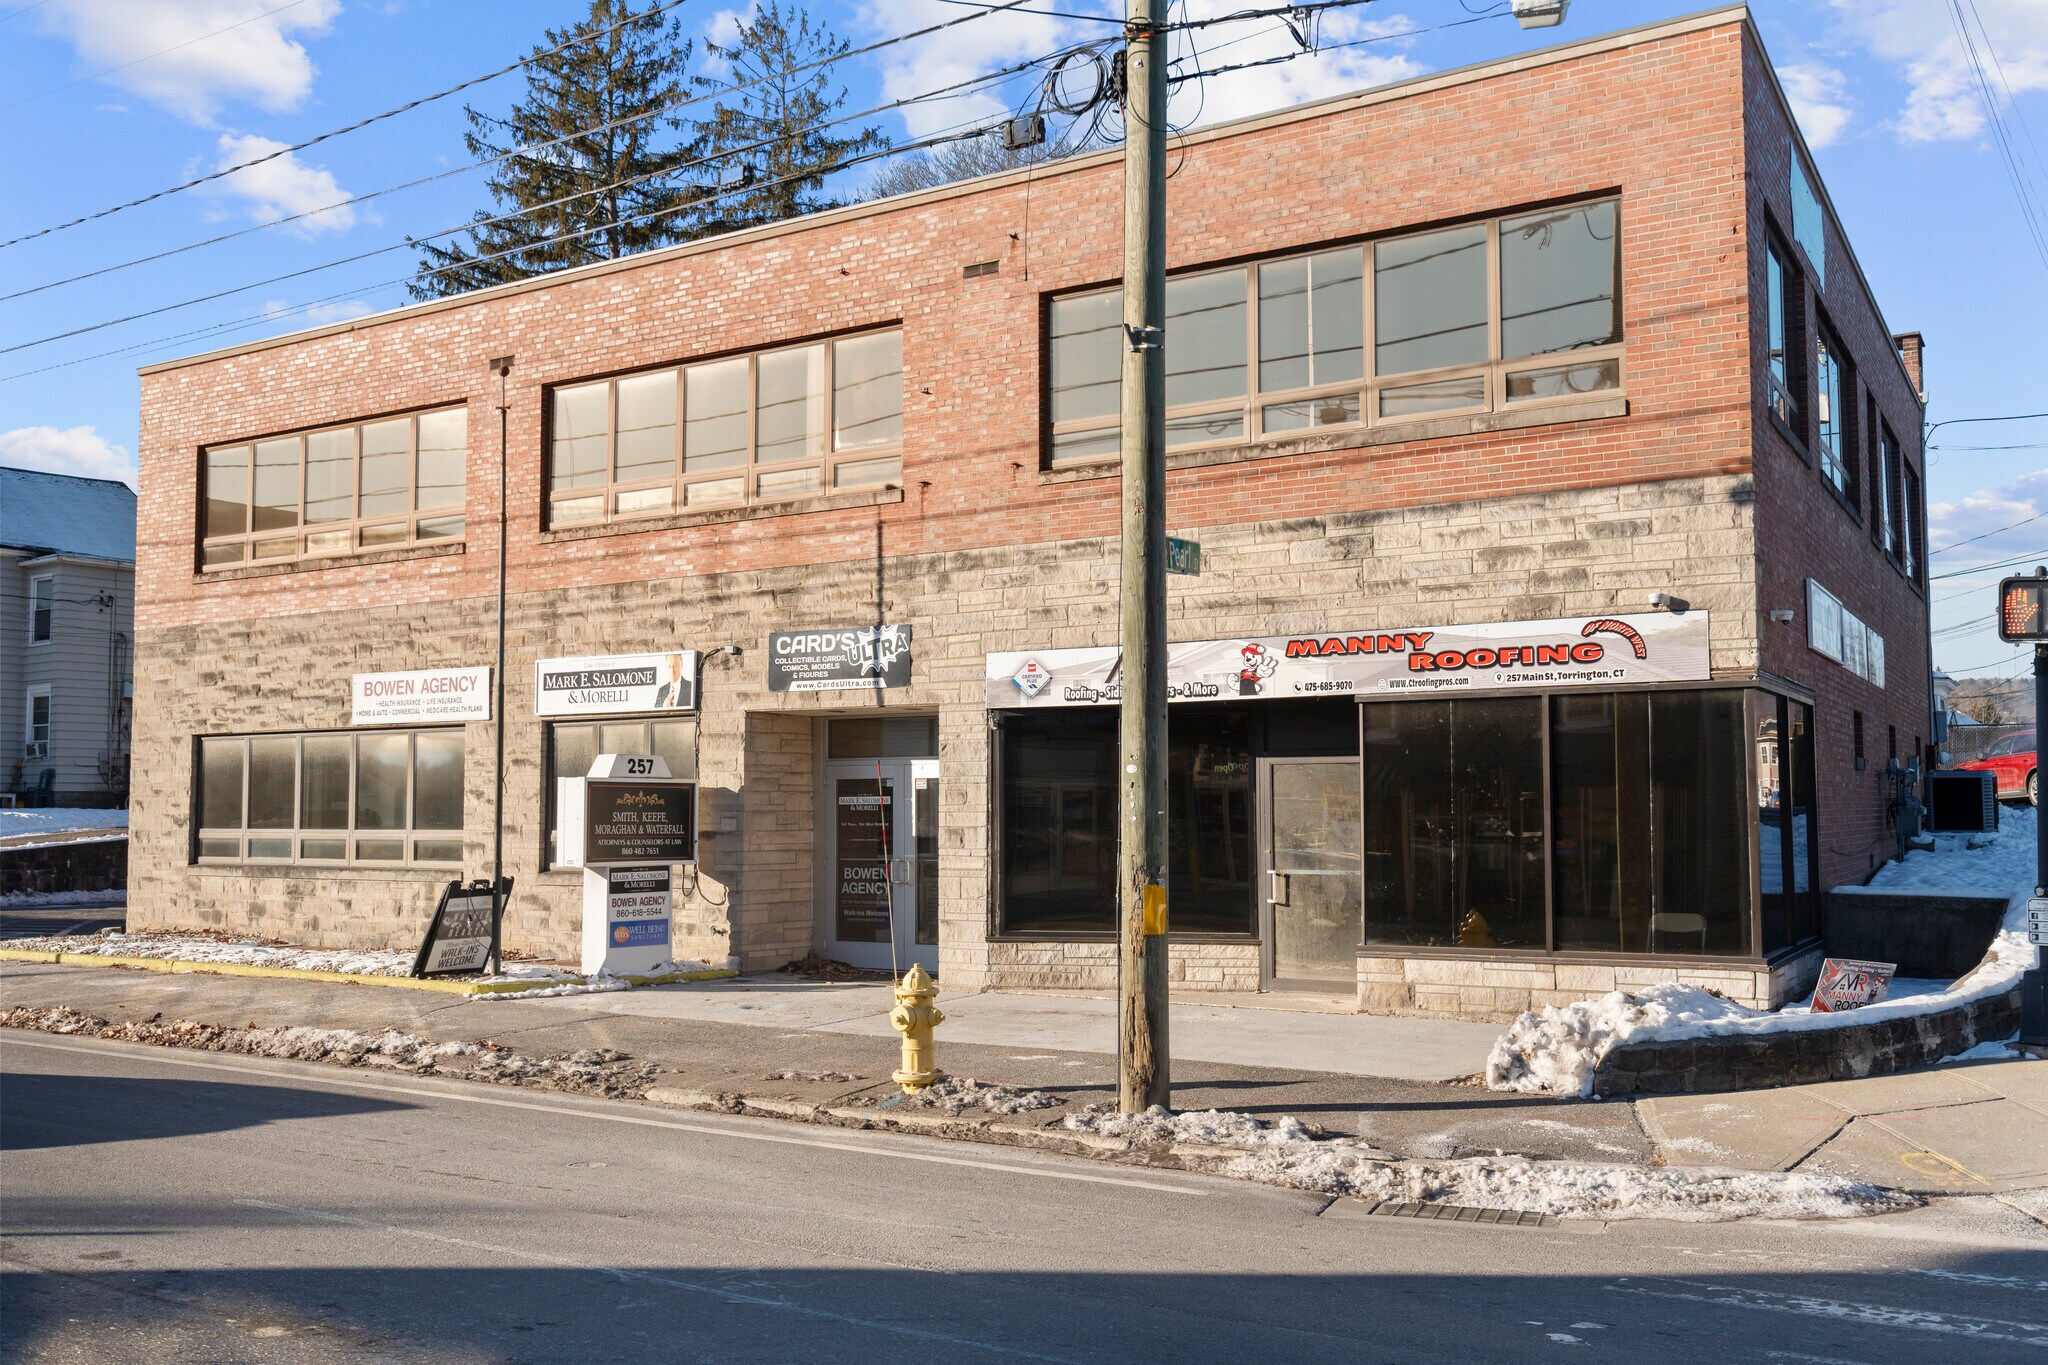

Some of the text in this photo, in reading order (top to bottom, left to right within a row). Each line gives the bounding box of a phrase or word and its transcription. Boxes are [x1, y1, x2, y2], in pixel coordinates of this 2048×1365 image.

[1169, 541, 1192, 569] Pearl
[1286, 632, 1434, 658] MANNY
[1598, 619, 1637, 638] NORTH
[1630, 634, 1647, 659] WEST
[776, 632, 908, 665] CARD'S ULTRA
[774, 656, 821, 665] COLLECTIBLE
[1409, 642, 1604, 672] ROOFING
[782, 664, 809, 672] COMICS,
[580, 672, 591, 687] E.
[1506, 674, 1522, 682] 257
[1522, 673, 1544, 681] Main
[1613, 669, 1625, 678] CT
[364, 675, 478, 697] BOWEN AGENCY
[796, 680, 879, 689] www.CardsUltra.com
[1183, 683, 1191, 696] &
[1193, 683, 1218, 696] More
[1305, 681, 1353, 692] 475-685-9070
[568, 691, 578, 704] &
[1065, 687, 1098, 702] Roofing
[391, 708, 420, 716] COMMERCIAL
[627, 758, 654, 775] 257
[612, 812, 669, 823] SMITH, KEEFE,
[594, 824, 685, 835] MORAGHAN & WATERFALL
[844, 867, 888, 880] BOWEN
[841, 882, 889, 894] AGENCY
[612, 896, 666, 908] BOWEN AGENCY
[616, 907, 662, 918] 860-618-5544
[629, 924, 666, 934] WELL BEING
[630, 933, 664, 941] SANCTUARY
[441, 945, 480, 959] WALK-INS
[437, 955, 476, 969] WELCOME
[1828, 991, 1863, 1001] MANNY
